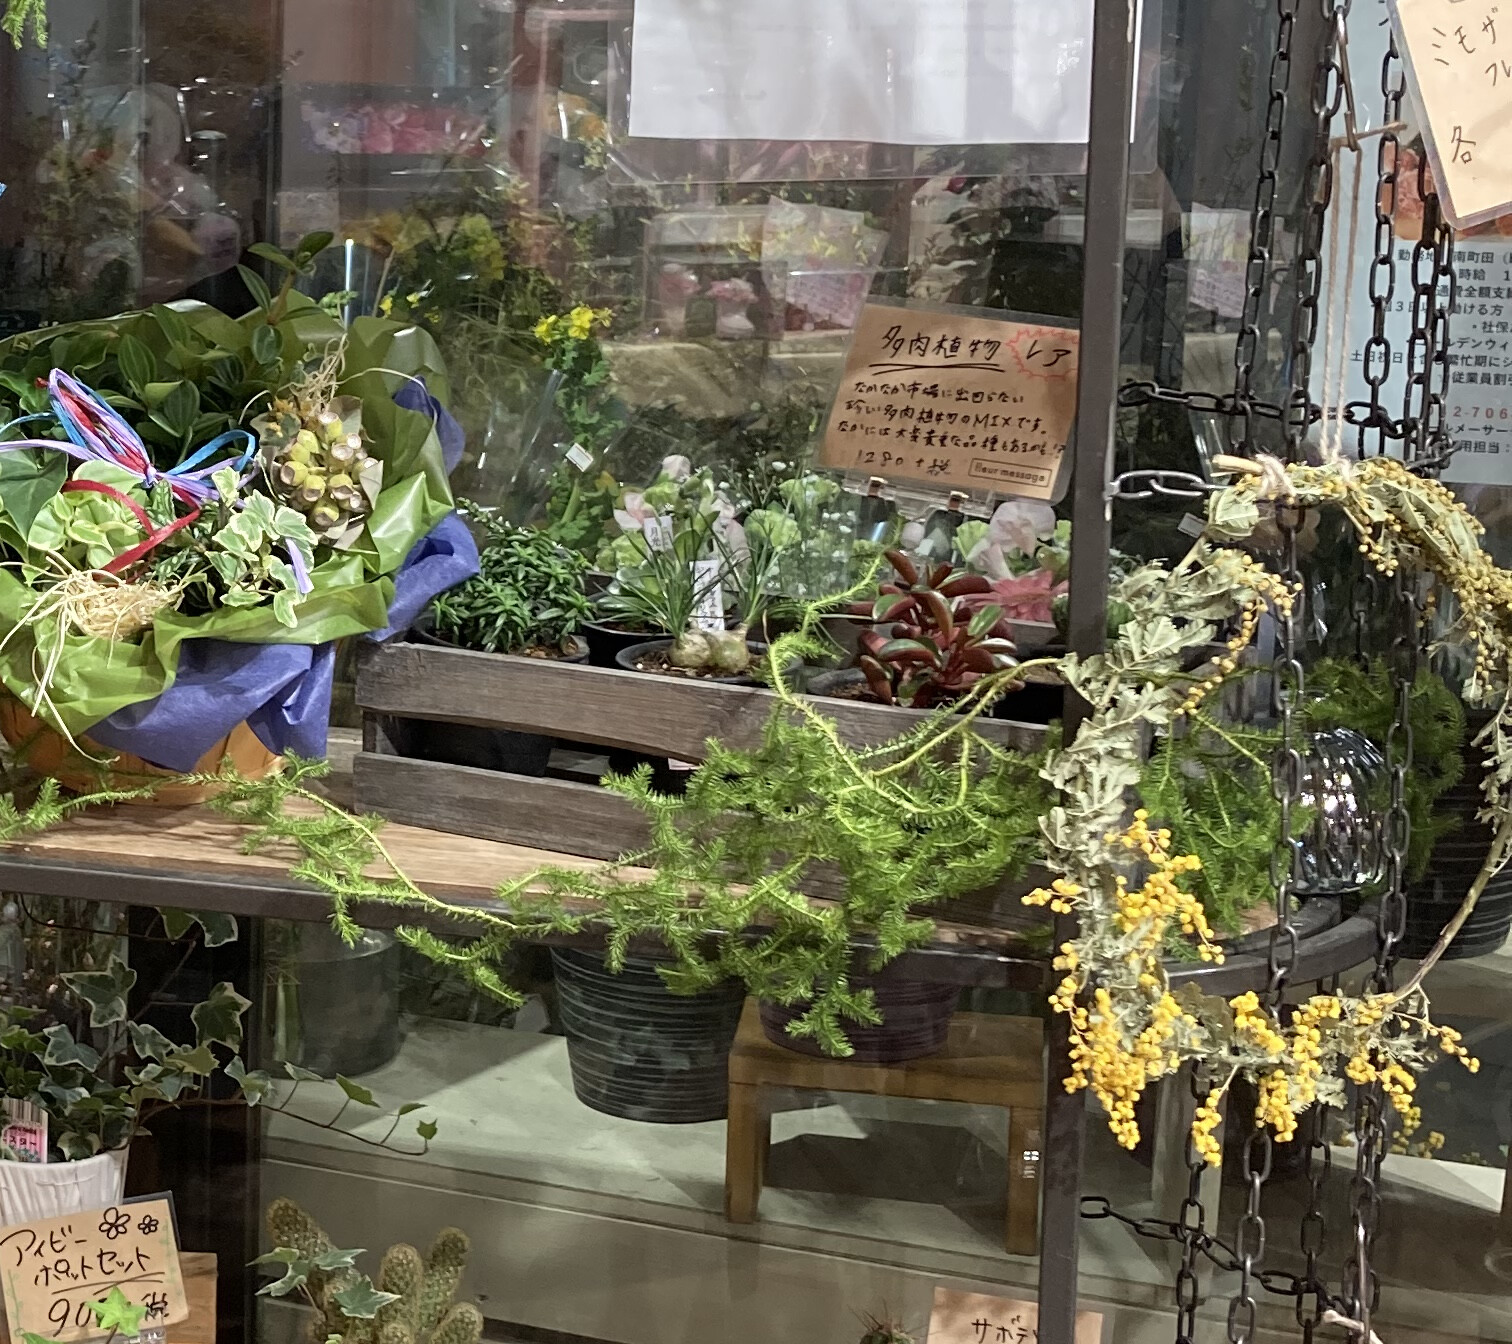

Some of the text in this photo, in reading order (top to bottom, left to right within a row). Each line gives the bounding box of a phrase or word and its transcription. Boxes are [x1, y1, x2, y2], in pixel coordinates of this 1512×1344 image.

[1451, 126, 1477, 164] 各
[1459, 269, 1486, 281] 時給
[882, 325, 1001, 360] 多肉植物
[1026, 340, 1072, 367] レア
[0, 1225, 87, 1266] アイビー
[35, 1246, 150, 1286] ポットセット
